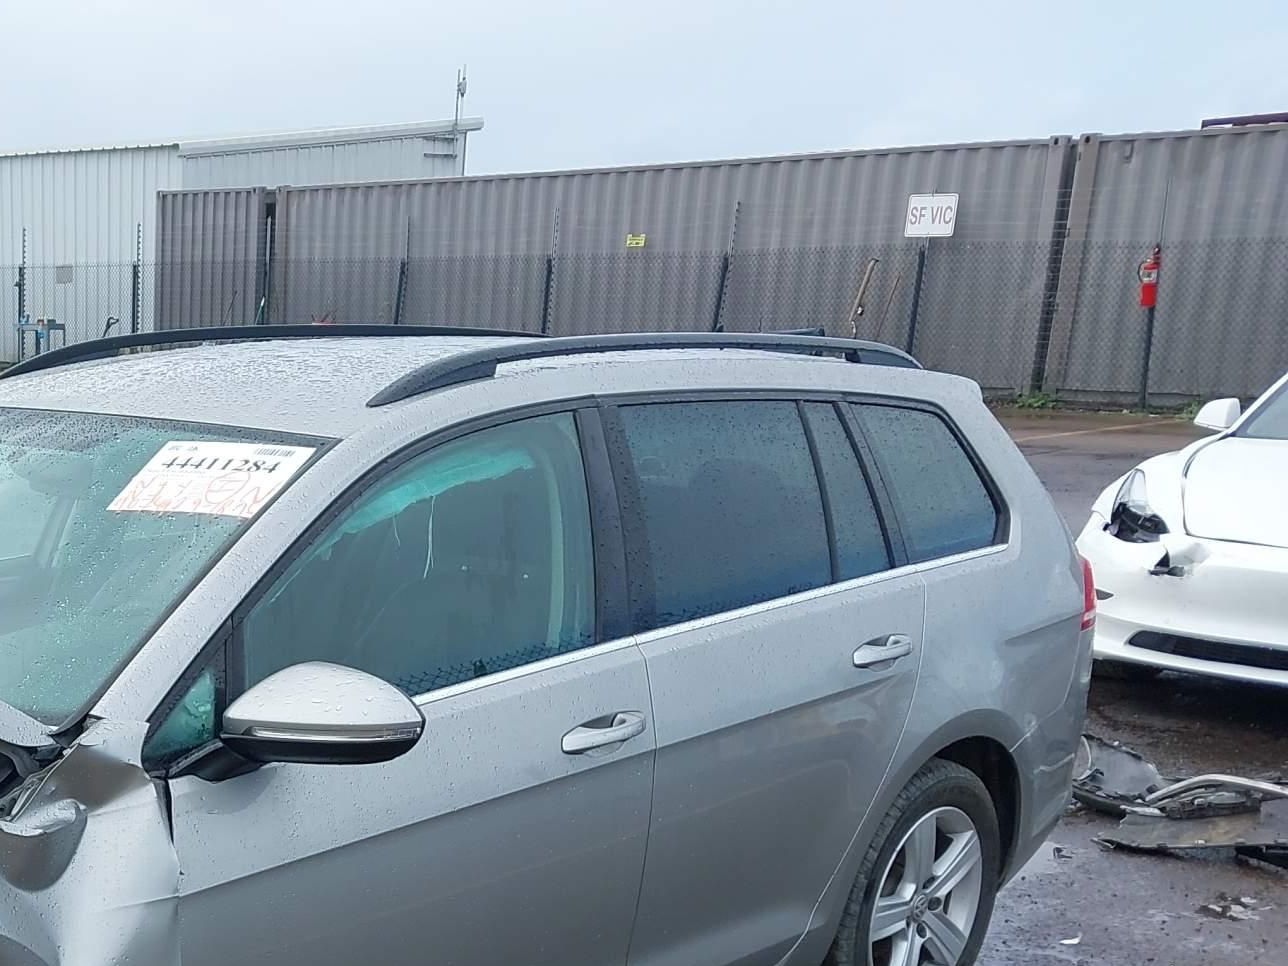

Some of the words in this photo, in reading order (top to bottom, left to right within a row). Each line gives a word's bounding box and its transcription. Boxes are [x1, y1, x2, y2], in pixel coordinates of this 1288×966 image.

[909, 206, 928, 225] SF
[930, 205, 953, 225] VIC
[161, 455, 281, 474] 44411284
